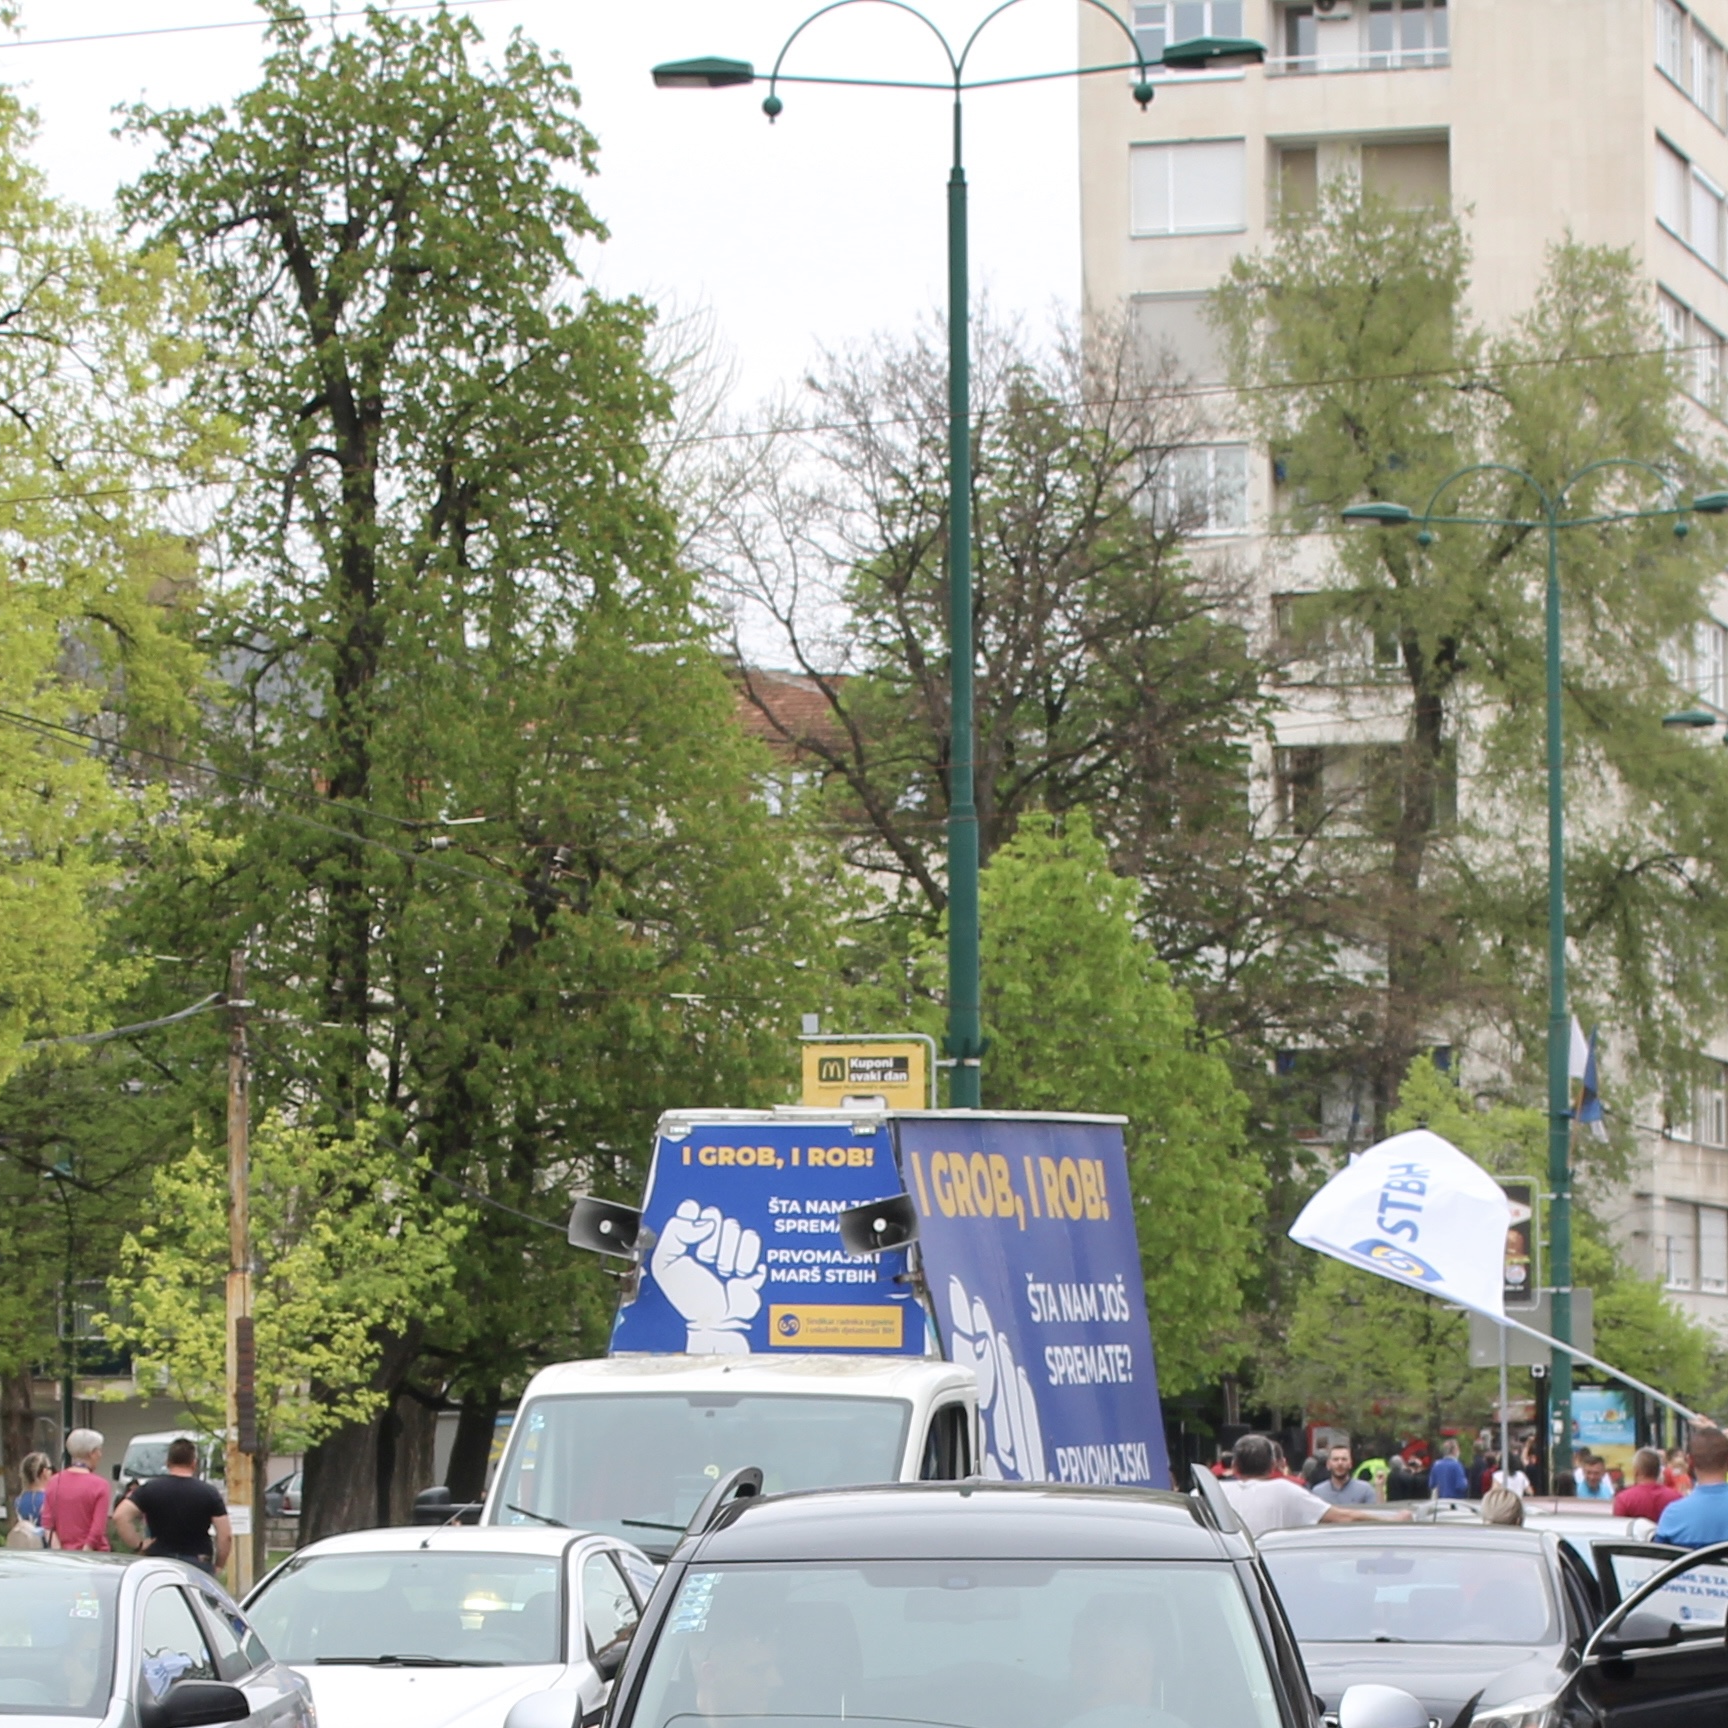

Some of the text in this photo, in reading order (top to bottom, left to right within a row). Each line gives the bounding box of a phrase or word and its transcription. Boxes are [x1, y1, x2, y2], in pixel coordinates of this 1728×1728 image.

[850, 1057, 894, 1070] Kuponi
[849, 1070, 907, 1082] svaki dan
[682, 1146, 874, 1170] I GROB, I ROB!
[910, 1151, 1111, 1231] I GROB, I ROB!
[768, 1196, 802, 1214] ŠTA
[806, 1200, 846, 1214] NAM
[770, 1266, 877, 1284] MARŠ STBIH
[1025, 1272, 1130, 1322] ŠTA NAM JOŠ
[1045, 1344, 1133, 1386] SPREMATE?
[1055, 1443, 1151, 1485] PRVOMAJSKI
